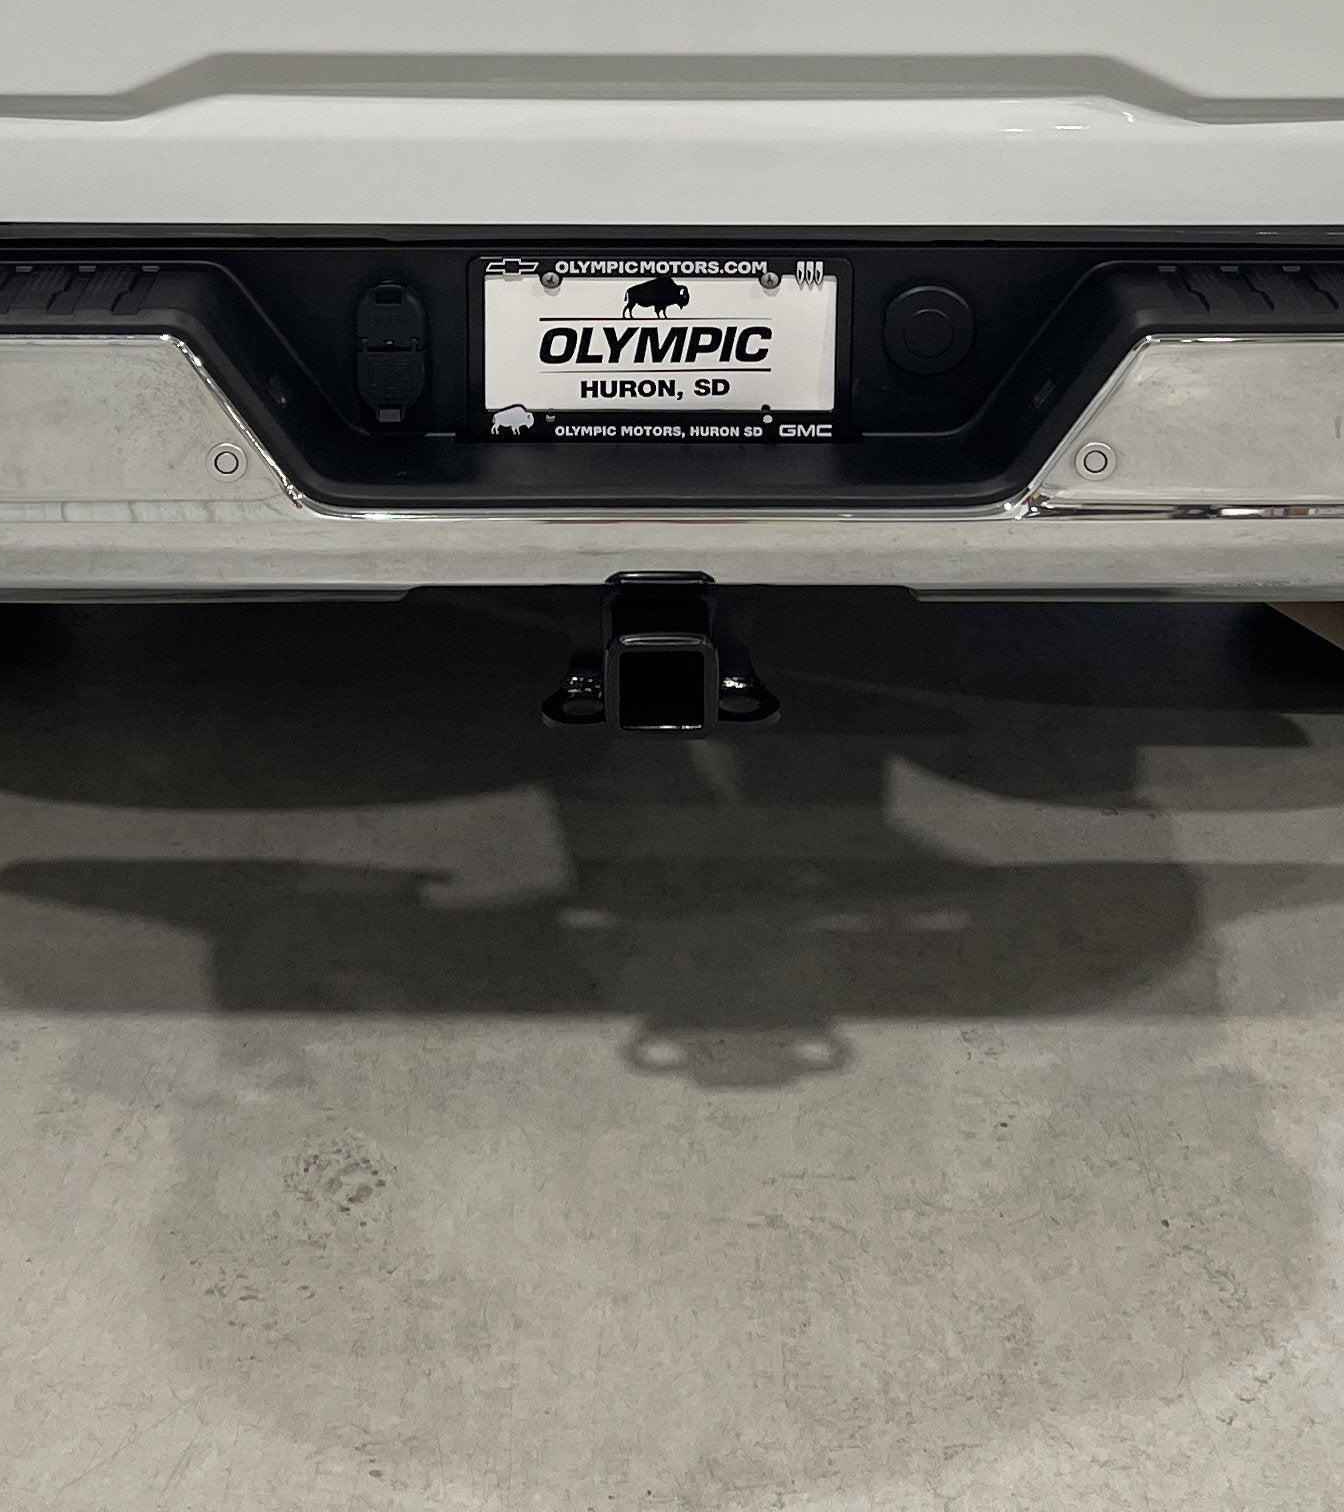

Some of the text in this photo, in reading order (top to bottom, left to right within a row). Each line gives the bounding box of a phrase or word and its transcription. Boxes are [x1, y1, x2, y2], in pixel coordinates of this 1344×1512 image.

[555, 260, 768, 275] OLYMPICMOTORS.COM
[539, 326, 773, 365] OLYMPIC
[580, 378, 730, 401] HURON, SD
[555, 425, 763, 439] OLYMPIC MOTORS, HURON SD
[779, 424, 833, 438] GMC
